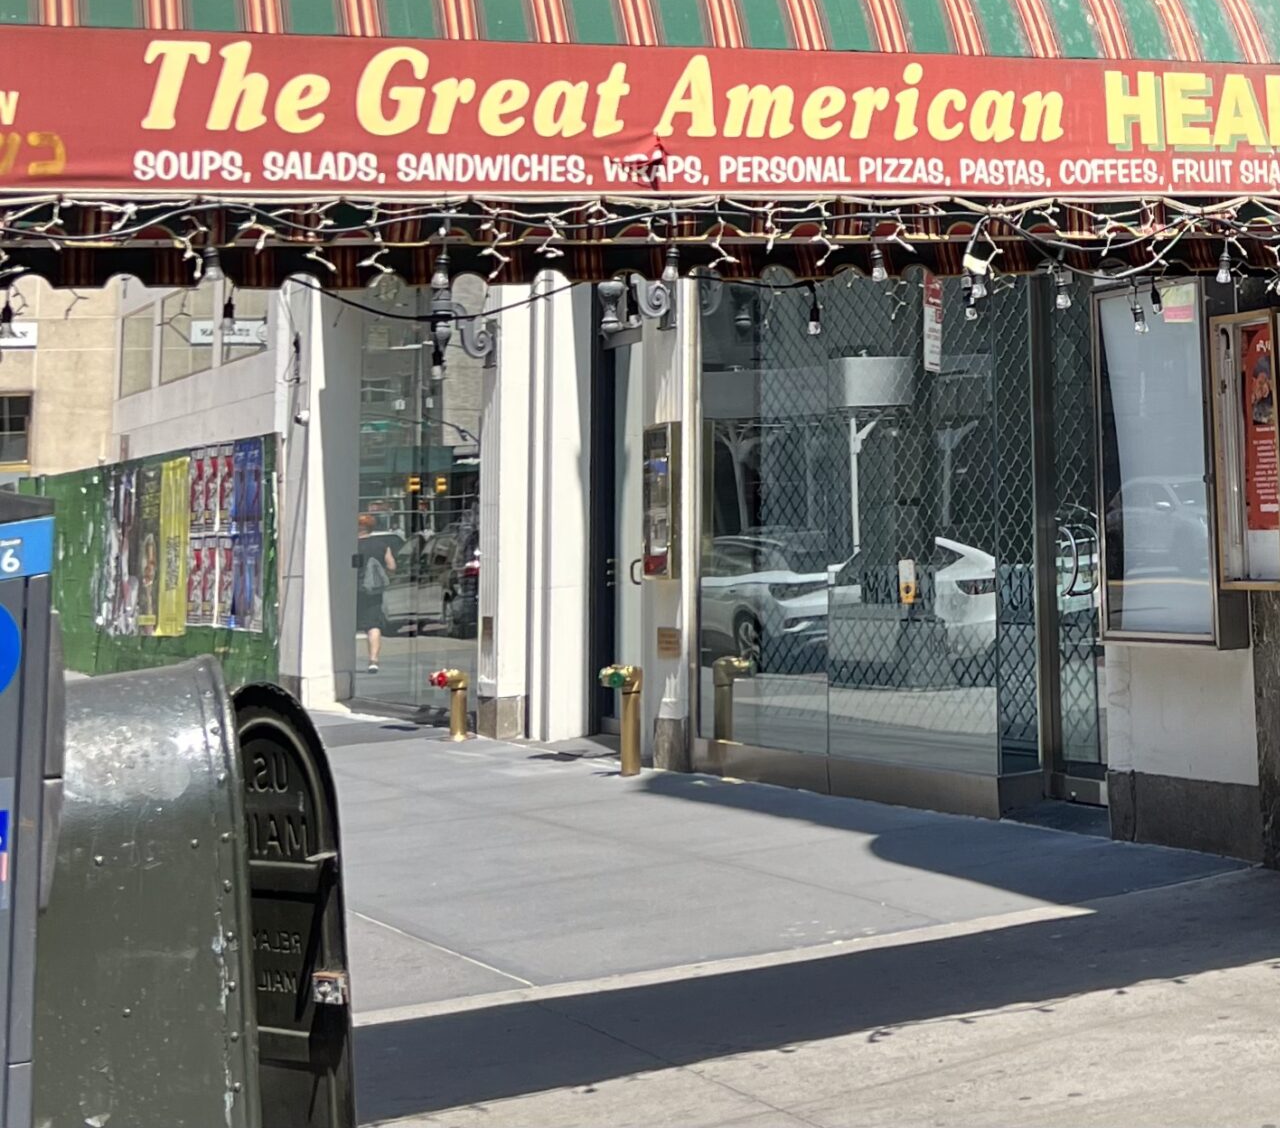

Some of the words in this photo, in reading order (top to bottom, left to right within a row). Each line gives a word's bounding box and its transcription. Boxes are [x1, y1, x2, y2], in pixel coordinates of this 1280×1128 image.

[141, 40, 331, 134] The
[356, 46, 631, 139] Great
[653, 54, 1065, 144] American
[133, 149, 251, 183] SOUPS,
[262, 150, 386, 184] SALADS,
[397, 151, 594, 185] SANDWICHES,
[719, 153, 852, 184] PERSONAL
[859, 156, 952, 186] PIZZAS,
[960, 158, 1052, 187] PASTAS,
[1059, 158, 1164, 186] COFFEES,
[1172, 158, 1232, 183] FRUIT
